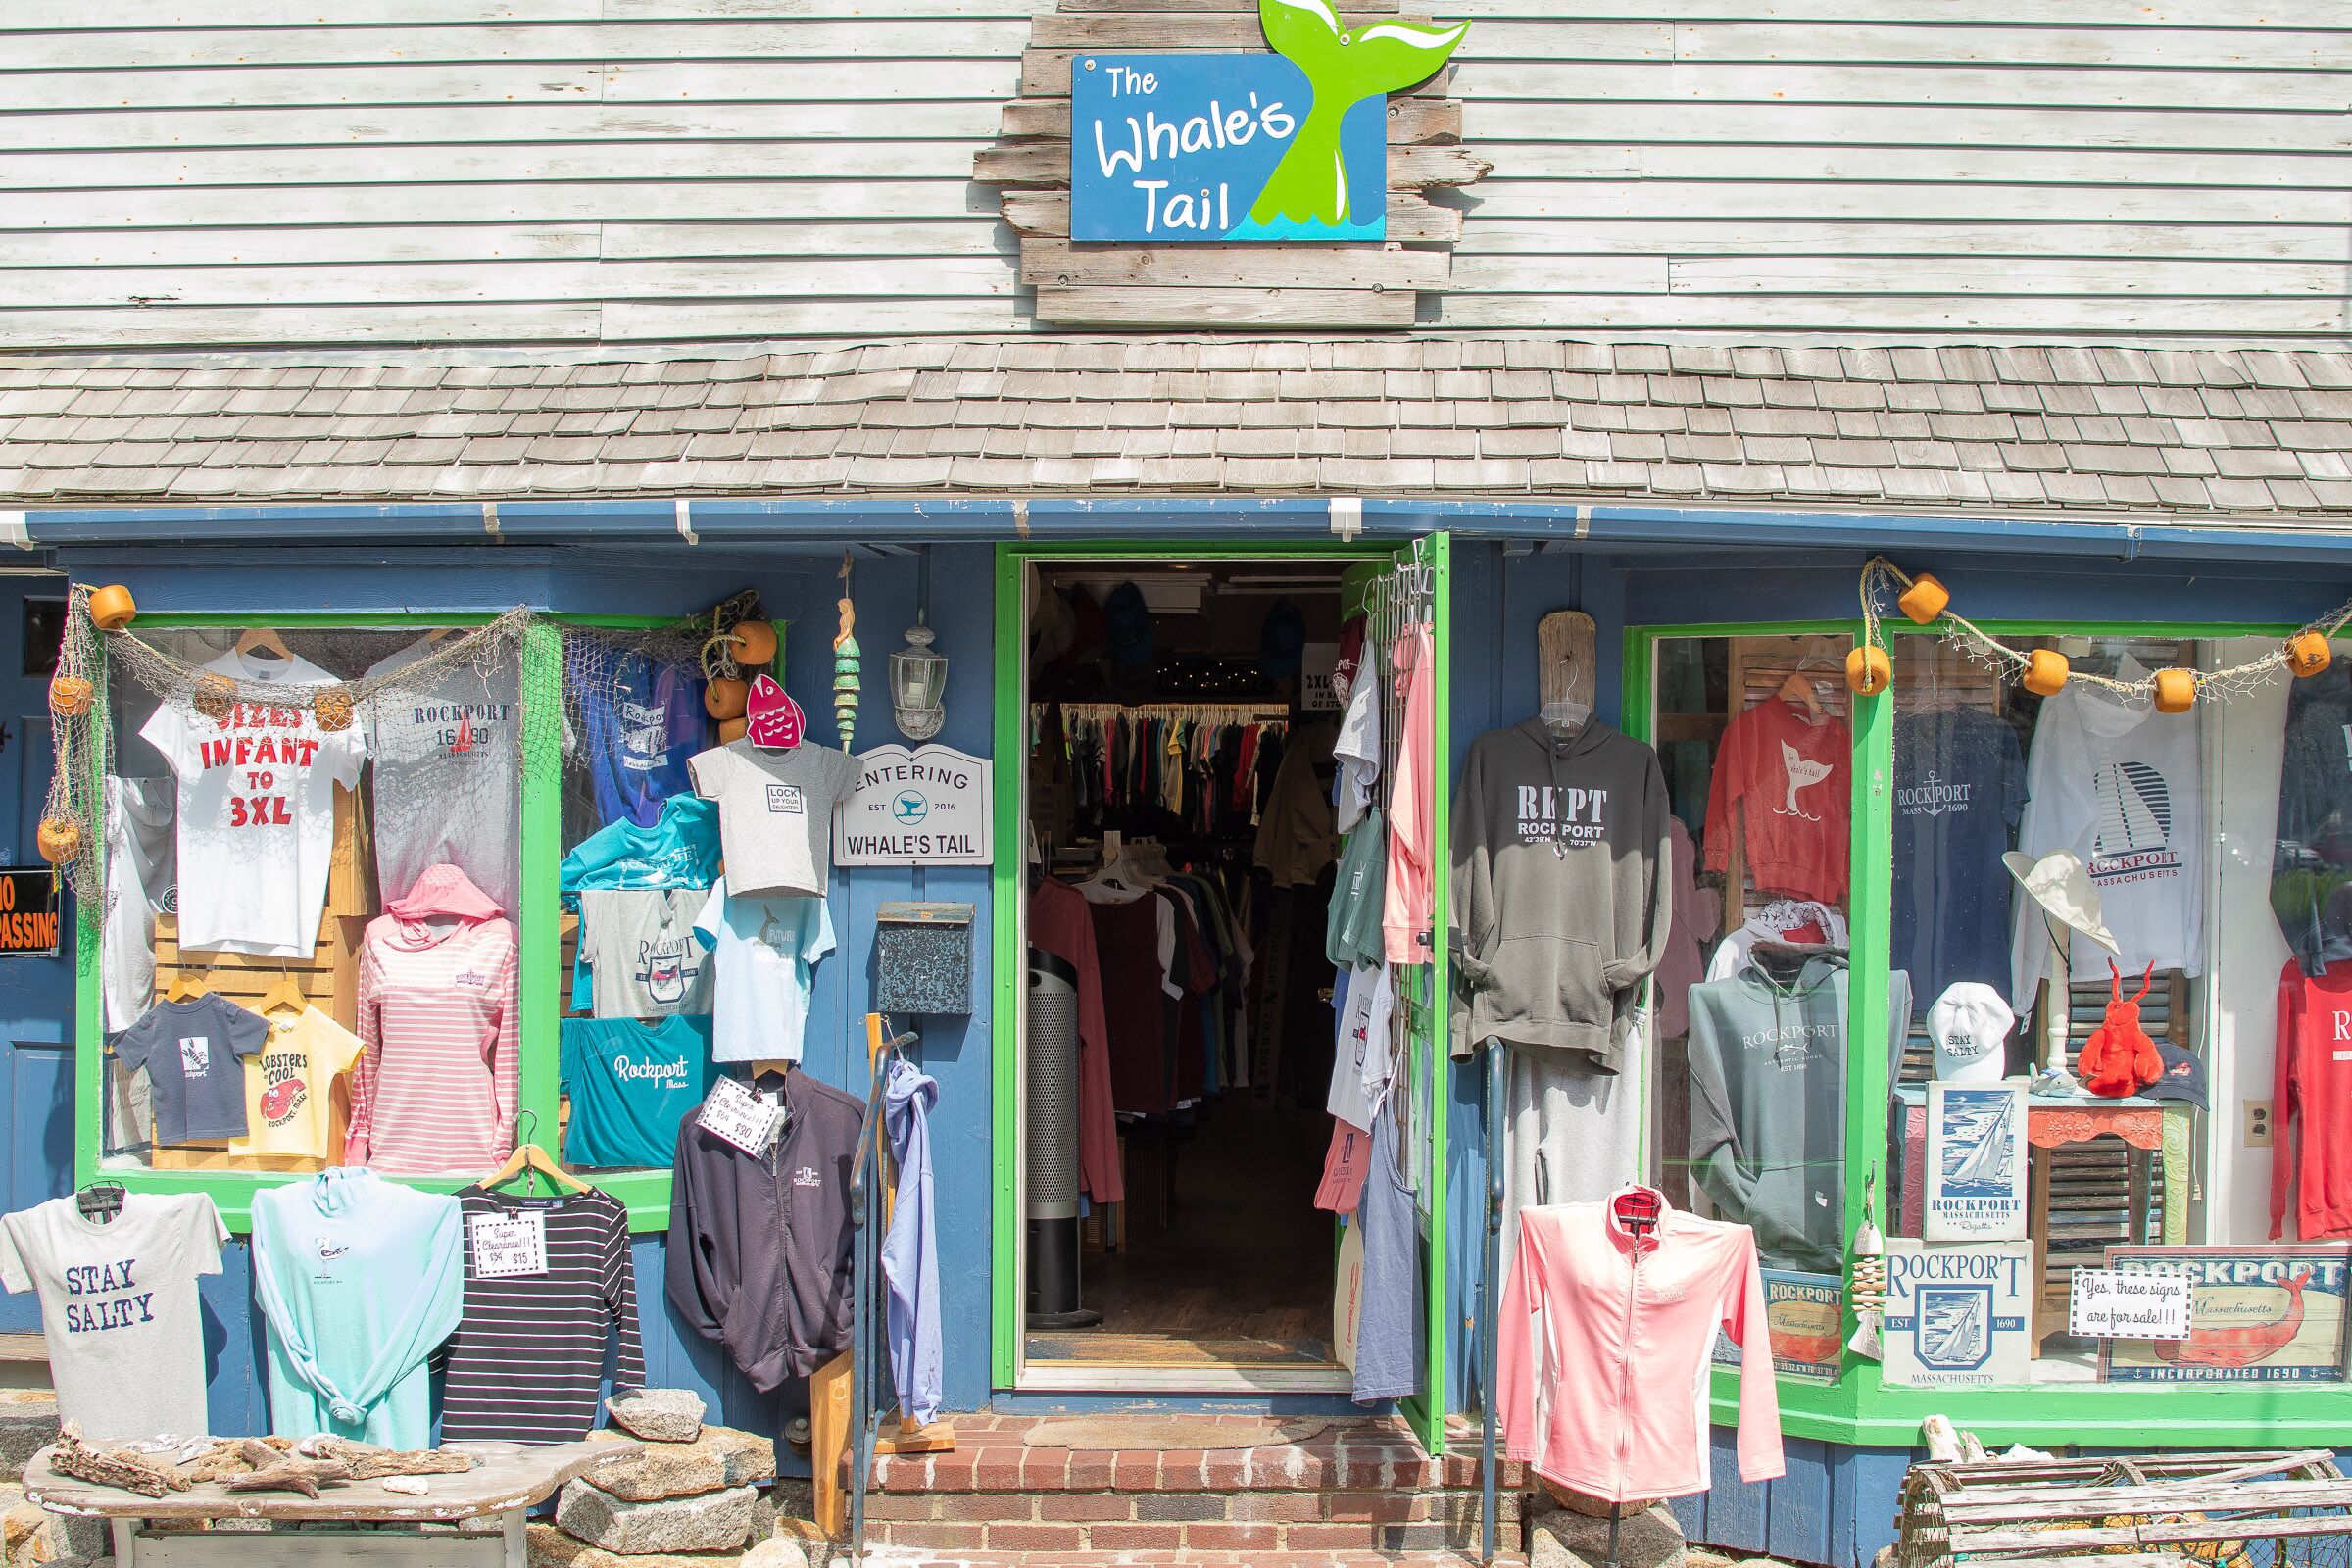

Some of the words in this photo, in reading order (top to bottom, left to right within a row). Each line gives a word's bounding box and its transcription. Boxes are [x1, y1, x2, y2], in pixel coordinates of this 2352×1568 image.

[1105, 66, 1158, 98] The
[1095, 91, 1296, 178] Whale's
[1133, 180, 1229, 233] Tail
[1306, 674, 1333, 689] 2XL
[414, 704, 510, 724] ROCKPORT
[200, 736, 318, 769] INFANT
[247, 770, 273, 790] TO
[770, 788, 798, 798] LOCK
[1896, 783, 1971, 806] ROCKPORT
[230, 796, 292, 827] 3XL
[1902, 807, 1922, 815] MASS
[1947, 804, 1968, 812] 1690
[848, 835, 931, 855] WHALE'S
[936, 835, 976, 854] TAIL
[2092, 869, 2179, 888] ASSACHUSETS
[0, 875, 15, 911] O
[0, 912, 58, 949] ASSING
[637, 935, 695, 965] ROCKPORT
[1742, 1024, 1838, 1050] ROCKPORT
[1947, 1034, 1972, 1045] STAY
[1946, 1045, 1979, 1057] SALTY
[269, 1066, 296, 1086] COOL
[613, 1054, 689, 1090] Rockport
[666, 1078, 690, 1089] Mass
[734, 1122, 753, 1139] $30
[1932, 1199, 2022, 1211] ROCKPORT
[1942, 1210, 2011, 1219] MASSACHUSETTS
[493, 1227, 517, 1243] Super
[1959, 1220, 1993, 1232] Regatta
[513, 1252, 528, 1264] $15
[66, 1258, 136, 1296] STAY
[1885, 1253, 2028, 1298] ROCKPORT
[1769, 1283, 1842, 1306] ROCKPORT
[2082, 1277, 2111, 1299] Yes,
[2115, 1278, 2148, 1295] these
[2149, 1281, 2181, 1303] signs
[66, 1292, 155, 1334] SALTY
[2191, 1296, 2274, 1315] Massachusetts
[1773, 1313, 1825, 1331] Massachusetts
[1891, 1317, 1911, 1329] EST
[1996, 1318, 2016, 1329] 1690
[2086, 1311, 2109, 1323] are
[2109, 1307, 2132, 1330] for
[2132, 1308, 2176, 1325] sale!!!
[1911, 1373, 1995, 1385] MASSACHUSETTS
[2150, 1367, 2259, 1380] INCORPORATED
[2266, 1367, 2301, 1380] 1690
